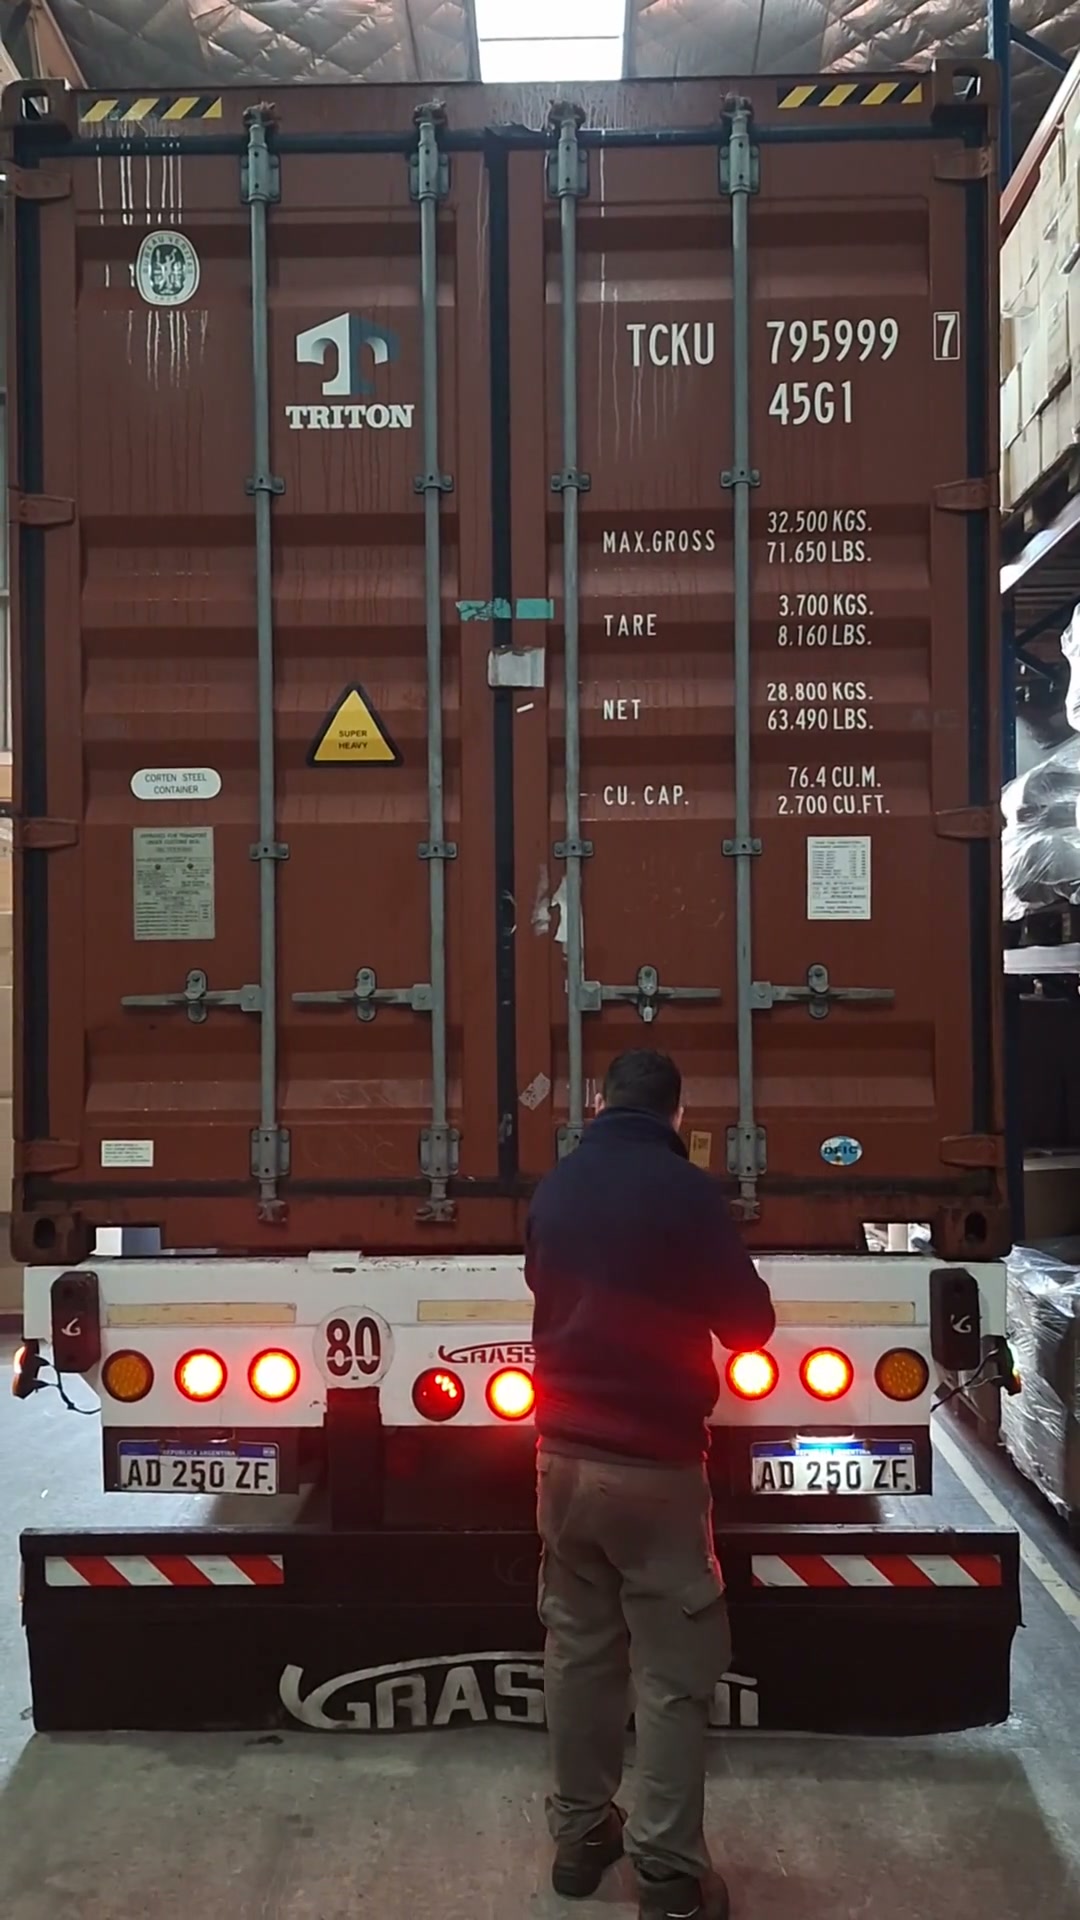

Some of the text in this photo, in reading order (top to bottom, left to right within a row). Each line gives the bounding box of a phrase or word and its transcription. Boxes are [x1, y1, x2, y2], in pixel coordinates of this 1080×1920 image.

[627, 314, 956, 367] TCKU 795999 7
[768, 380, 852, 425] 45G1
[285, 404, 415, 430] TRITON
[767, 509, 872, 533] 32.500 KGS.
[603, 529, 716, 553] MAX.GROSS
[767, 540, 872, 563] 71.650 LBS.
[779, 593, 874, 616] 3.700 KGS.
[604, 613, 658, 637] TARE
[777, 624, 872, 647] 8.160 LBS.
[767, 682, 873, 701] 28.800 KGS.
[603, 699, 642, 720] NET
[767, 708, 874, 730] 63.490 LBS.
[338, 729, 368, 738] SUPER
[338, 741, 368, 750] HEAVY
[144, 772, 207, 783] CORTEN STEEL
[788, 766, 882, 789] 76.4 CU.M.
[153, 785, 199, 795] CONTAINER
[604, 785, 690, 806] CU. CAP.
[778, 794, 891, 815] 2.700 CU.FT.
[326, 1317, 381, 1376] 80
[438, 1341, 537, 1364] GRASS
[127, 1459, 269, 1489] AD 250 ZF
[760, 1459, 907, 1490] AD 250 ZF
